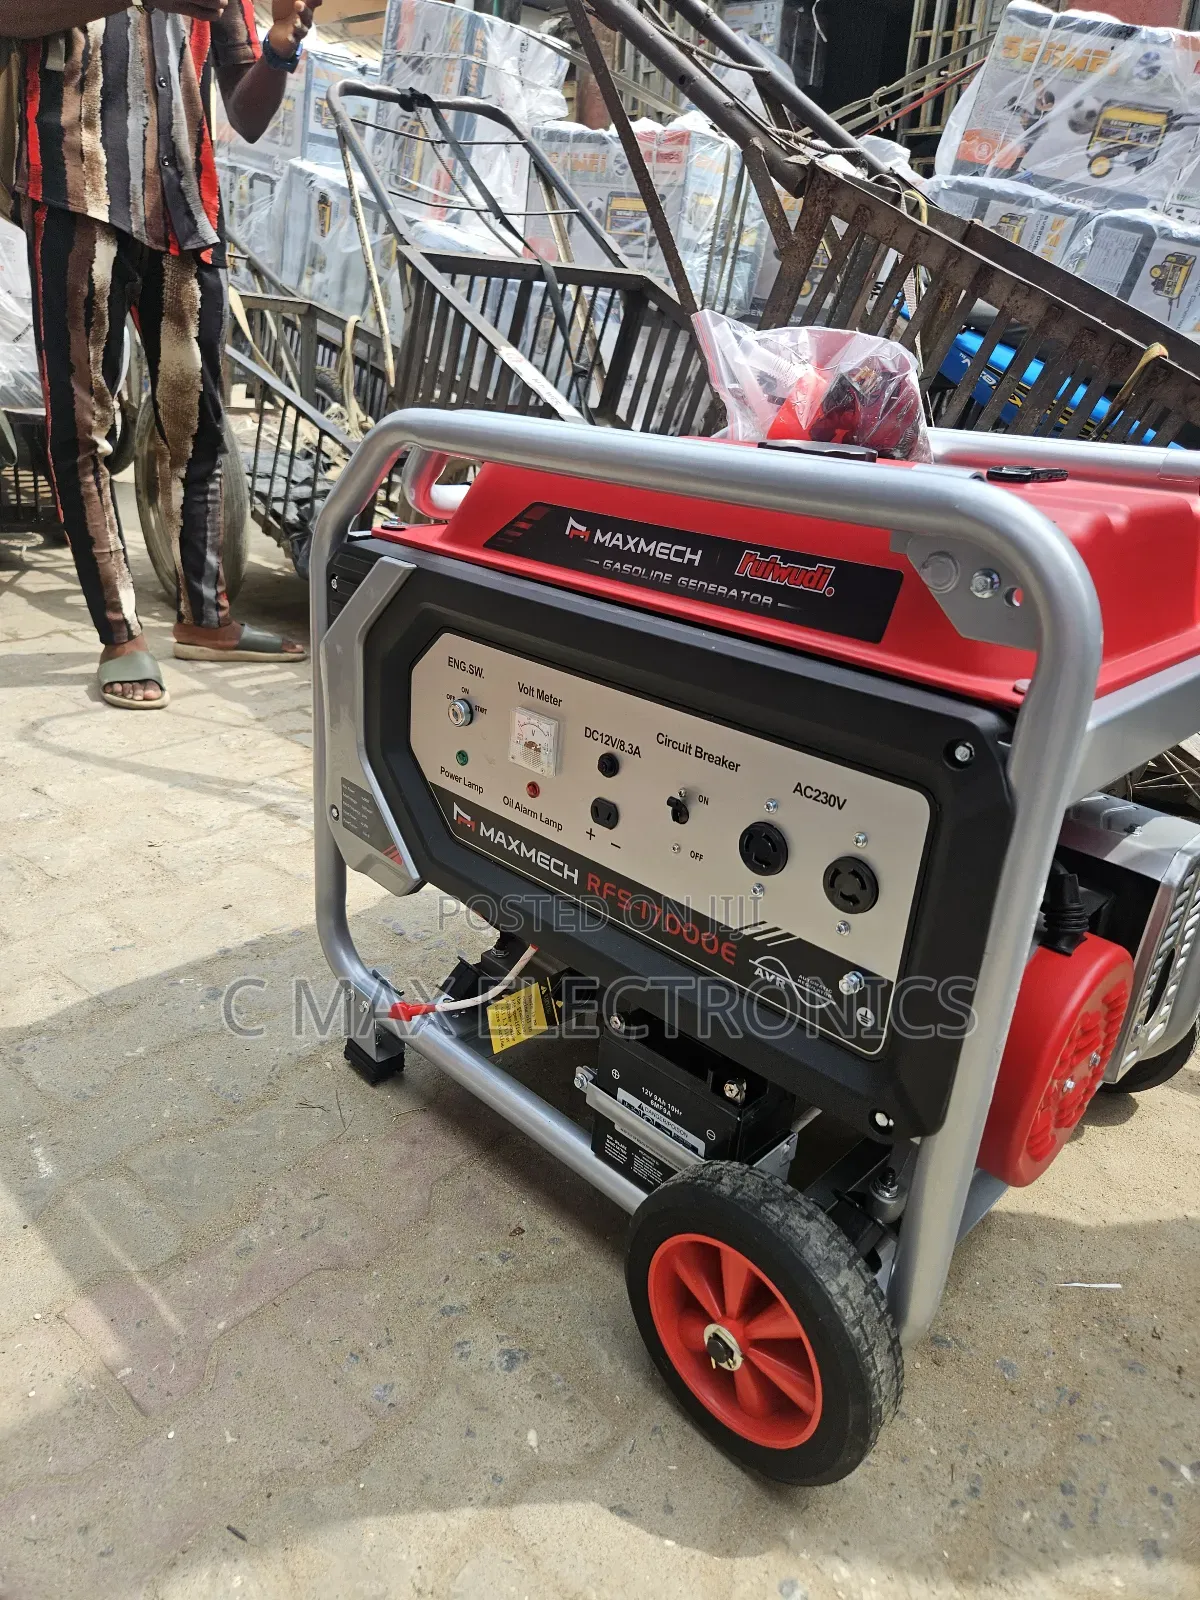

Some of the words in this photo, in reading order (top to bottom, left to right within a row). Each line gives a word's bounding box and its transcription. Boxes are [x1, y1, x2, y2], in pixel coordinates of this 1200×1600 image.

[592, 528, 703, 567] MAXMECH
[602, 560, 672, 585] GASOLINE
[677, 576, 773, 608] GENERATOR
[447, 656, 485, 679] ENG.SW.
[461, 686, 469, 695] ON
[517, 681, 535, 698] Volt
[536, 689, 563, 708] Meter
[584, 726, 642, 758] DC12V/8.3A
[656, 732, 692, 756] Circuit
[694, 745, 741, 772] Breaker
[440, 766, 463, 784] Power
[464, 775, 484, 795] Lamp
[697, 794, 709, 806] ON
[792, 781, 848, 811] AC230V
[502, 795, 515, 808] Oil
[515, 800, 538, 819] Alarm
[540, 813, 563, 832] Lamp
[479, 821, 579, 885] MAXMECH
[689, 850, 704, 861] OFF
[754, 967, 786, 990] AVR
[641, 1086, 653, 1097] 12V
[653, 1093, 667, 1106] 9Ah
[667, 1103, 683, 1116] 10Hr
